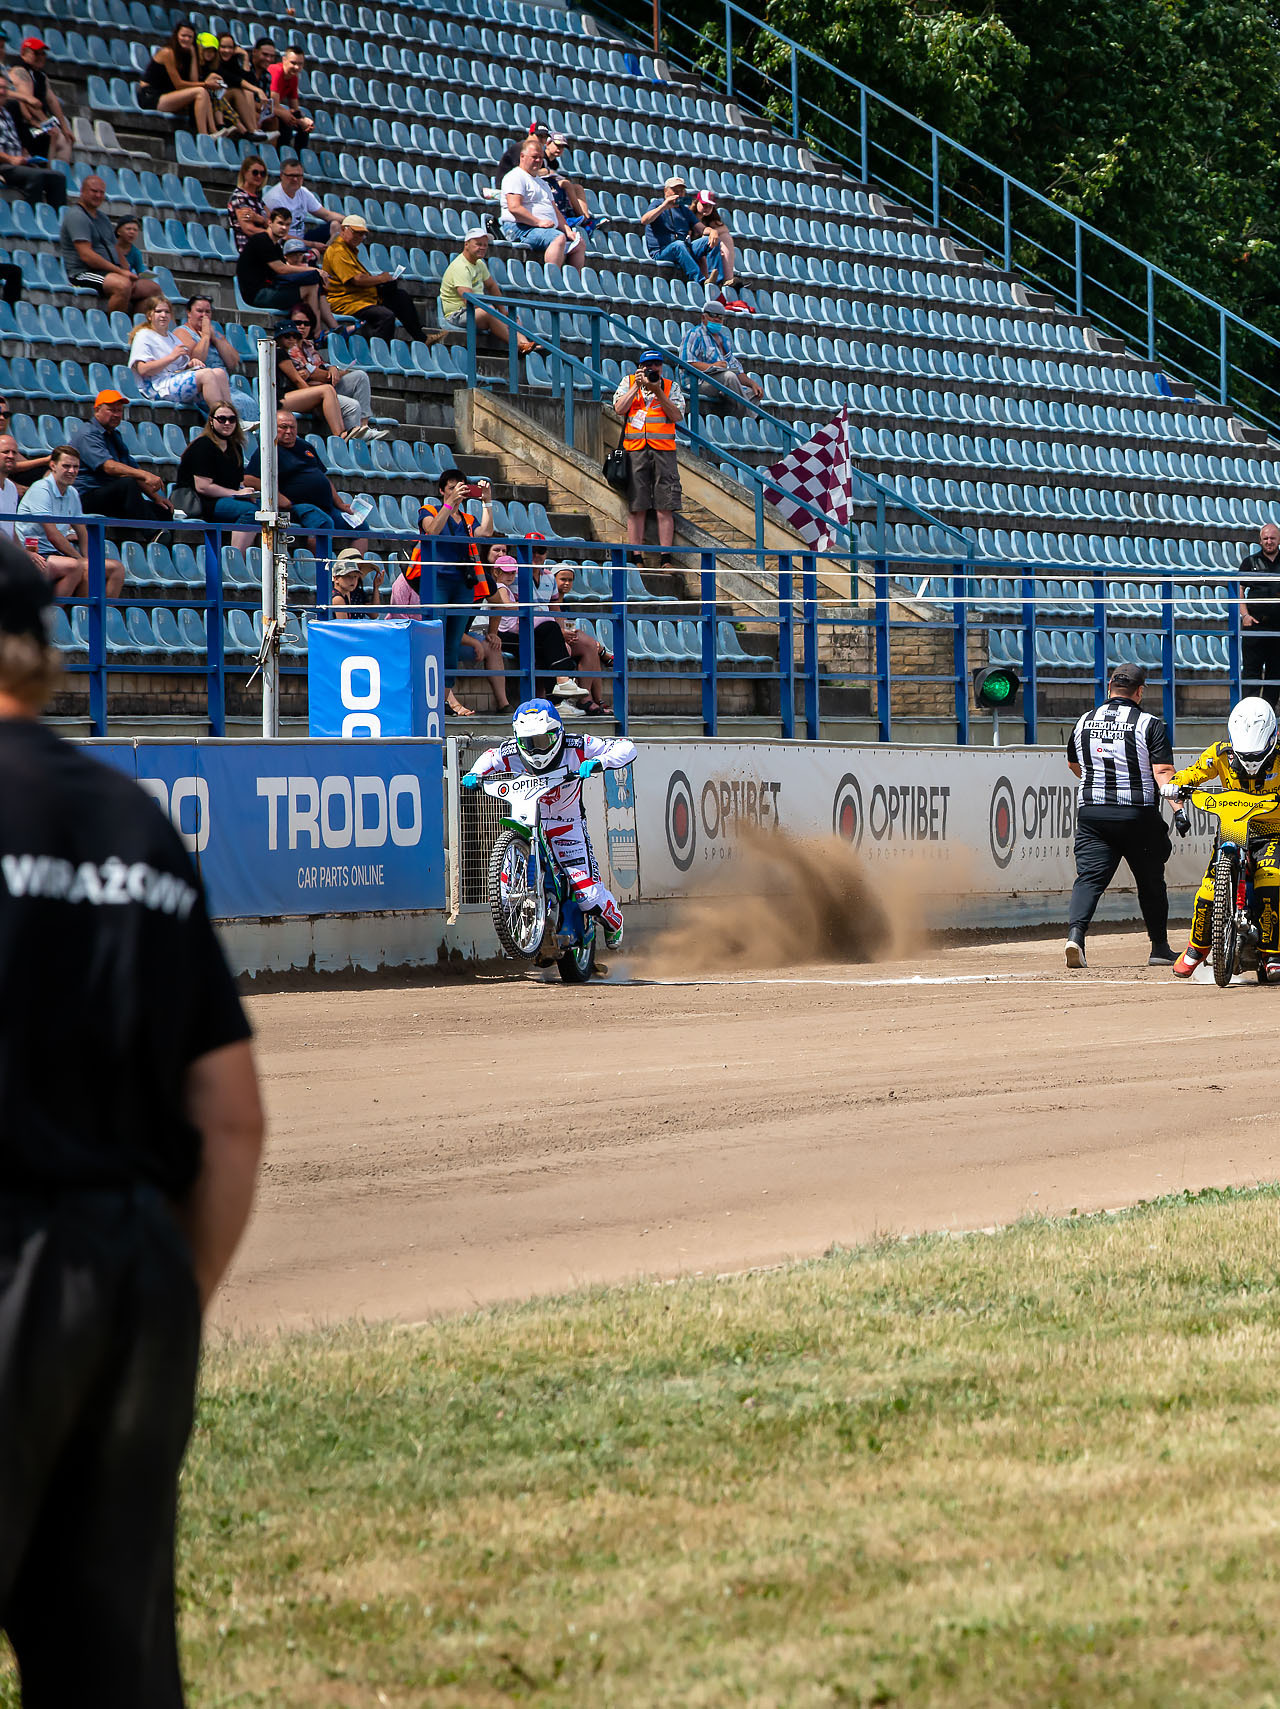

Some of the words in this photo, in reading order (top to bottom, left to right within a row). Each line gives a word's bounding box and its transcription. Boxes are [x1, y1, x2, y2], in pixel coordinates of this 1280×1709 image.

[1083, 720, 1135, 732] KIEROWNIK
[1089, 729, 1126, 740] STARTU
[257, 774, 422, 850] TRODO
[701, 779, 782, 840] OPTIBET
[869, 783, 951, 841] OPTIBET
[1021, 785, 1080, 840] OPTIBE
[1218, 799, 1264, 809] spechouse
[297, 866, 318, 889] CAR
[320, 865, 349, 888] PARTS
[351, 864, 385, 887] ONLINE
